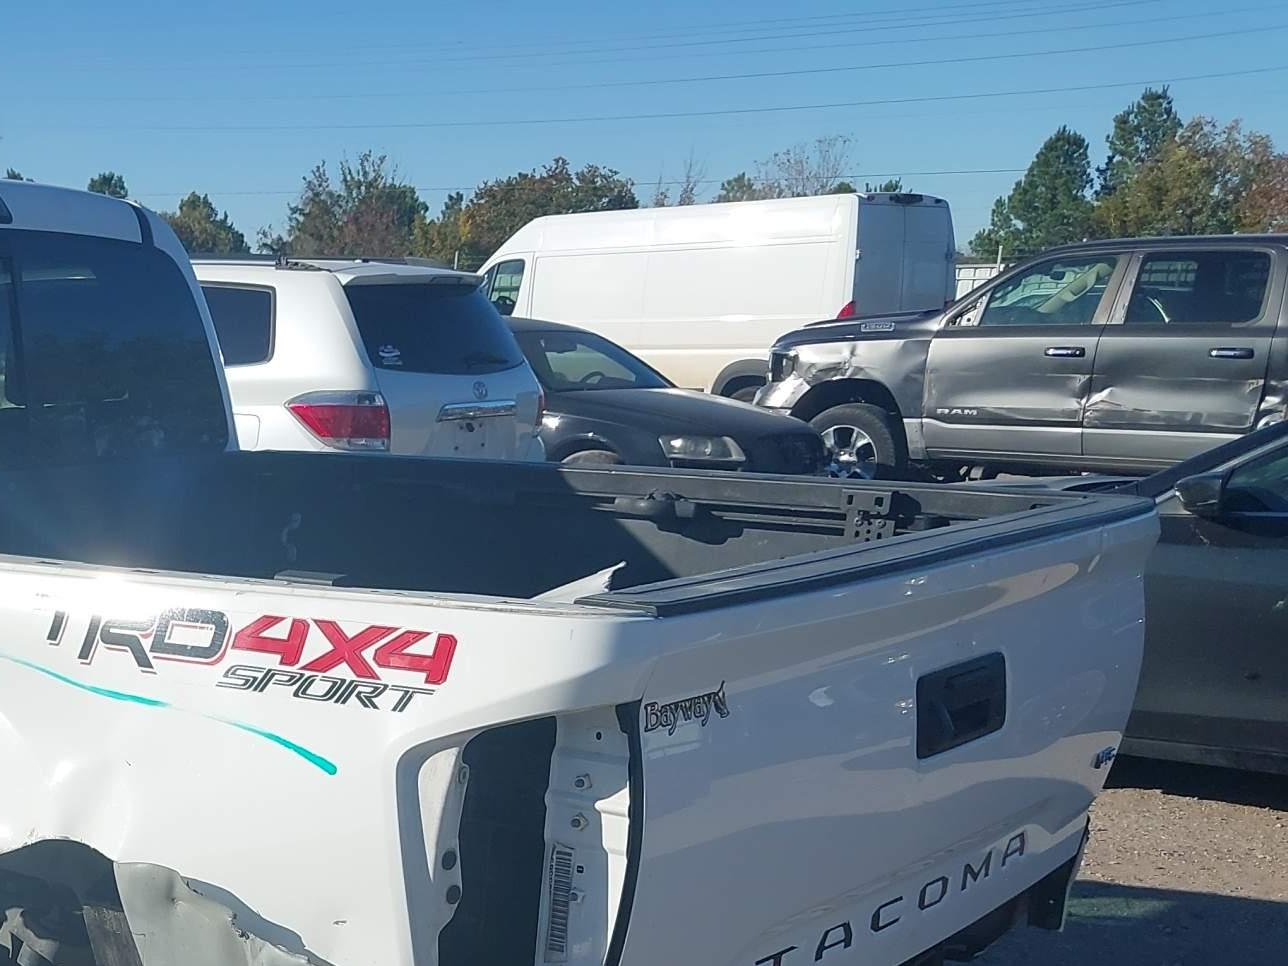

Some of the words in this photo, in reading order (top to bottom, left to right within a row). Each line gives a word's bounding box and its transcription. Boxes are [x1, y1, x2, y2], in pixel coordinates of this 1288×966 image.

[935, 407, 978, 416] RAM
[44, 604, 232, 675] TRD
[216, 664, 436, 714] SPORT
